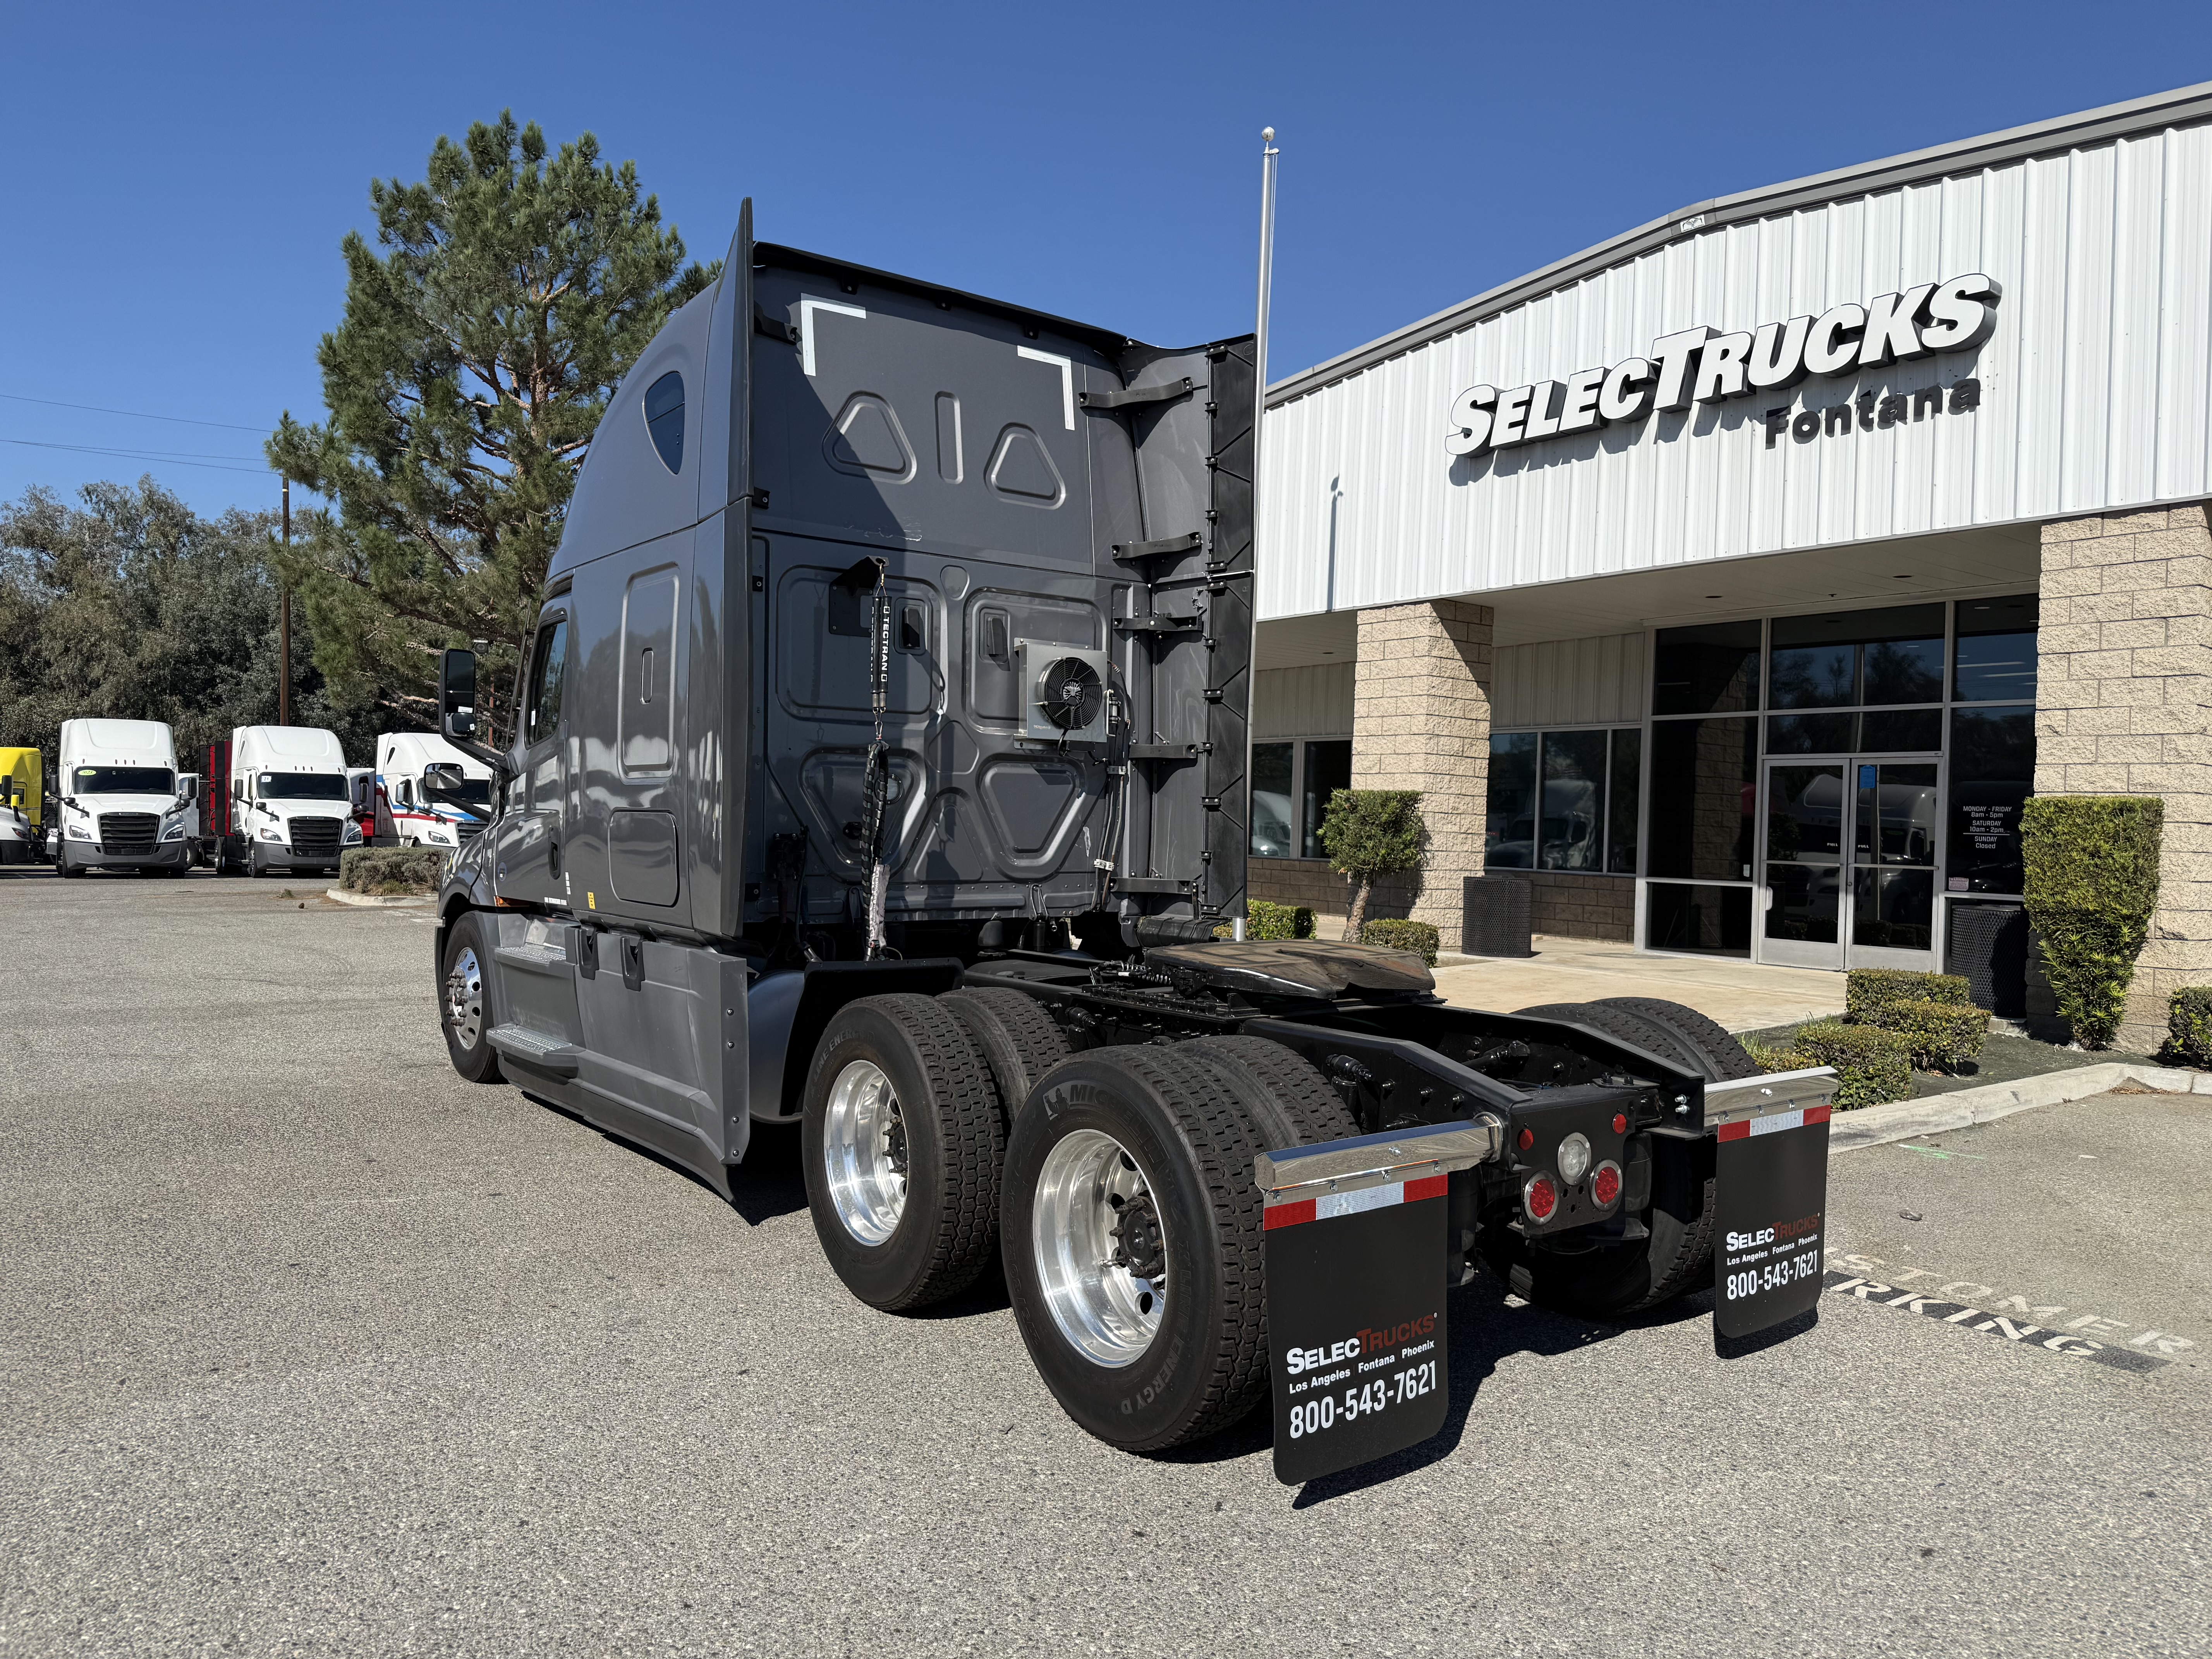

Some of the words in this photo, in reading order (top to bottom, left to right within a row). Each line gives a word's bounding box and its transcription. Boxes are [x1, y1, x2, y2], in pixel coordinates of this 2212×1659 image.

[1765, 378, 1981, 449] Fontana
[881, 617, 890, 671] TECTRAN
[1727, 1257, 1740, 1266] Los
[1741, 1250, 1768, 1262] Angeles
[1772, 1242, 1795, 1255] Fontana
[1798, 1233, 1817, 1246] Phoenix
[1727, 1249, 1817, 1300] 800-543-7621
[1823, 1269, 2104, 1356] RKING
[1137, 1333, 1185, 1410] ENERGY
[1289, 1381, 1308, 1395] Los
[1310, 1368, 1351, 1388] Angeles
[1358, 1354, 1395, 1374] Fontana
[1401, 1340, 1435, 1359] Phoenix
[1121, 1397, 1134, 1415] D
[1290, 1360, 1436, 1439] 800-543-7621
